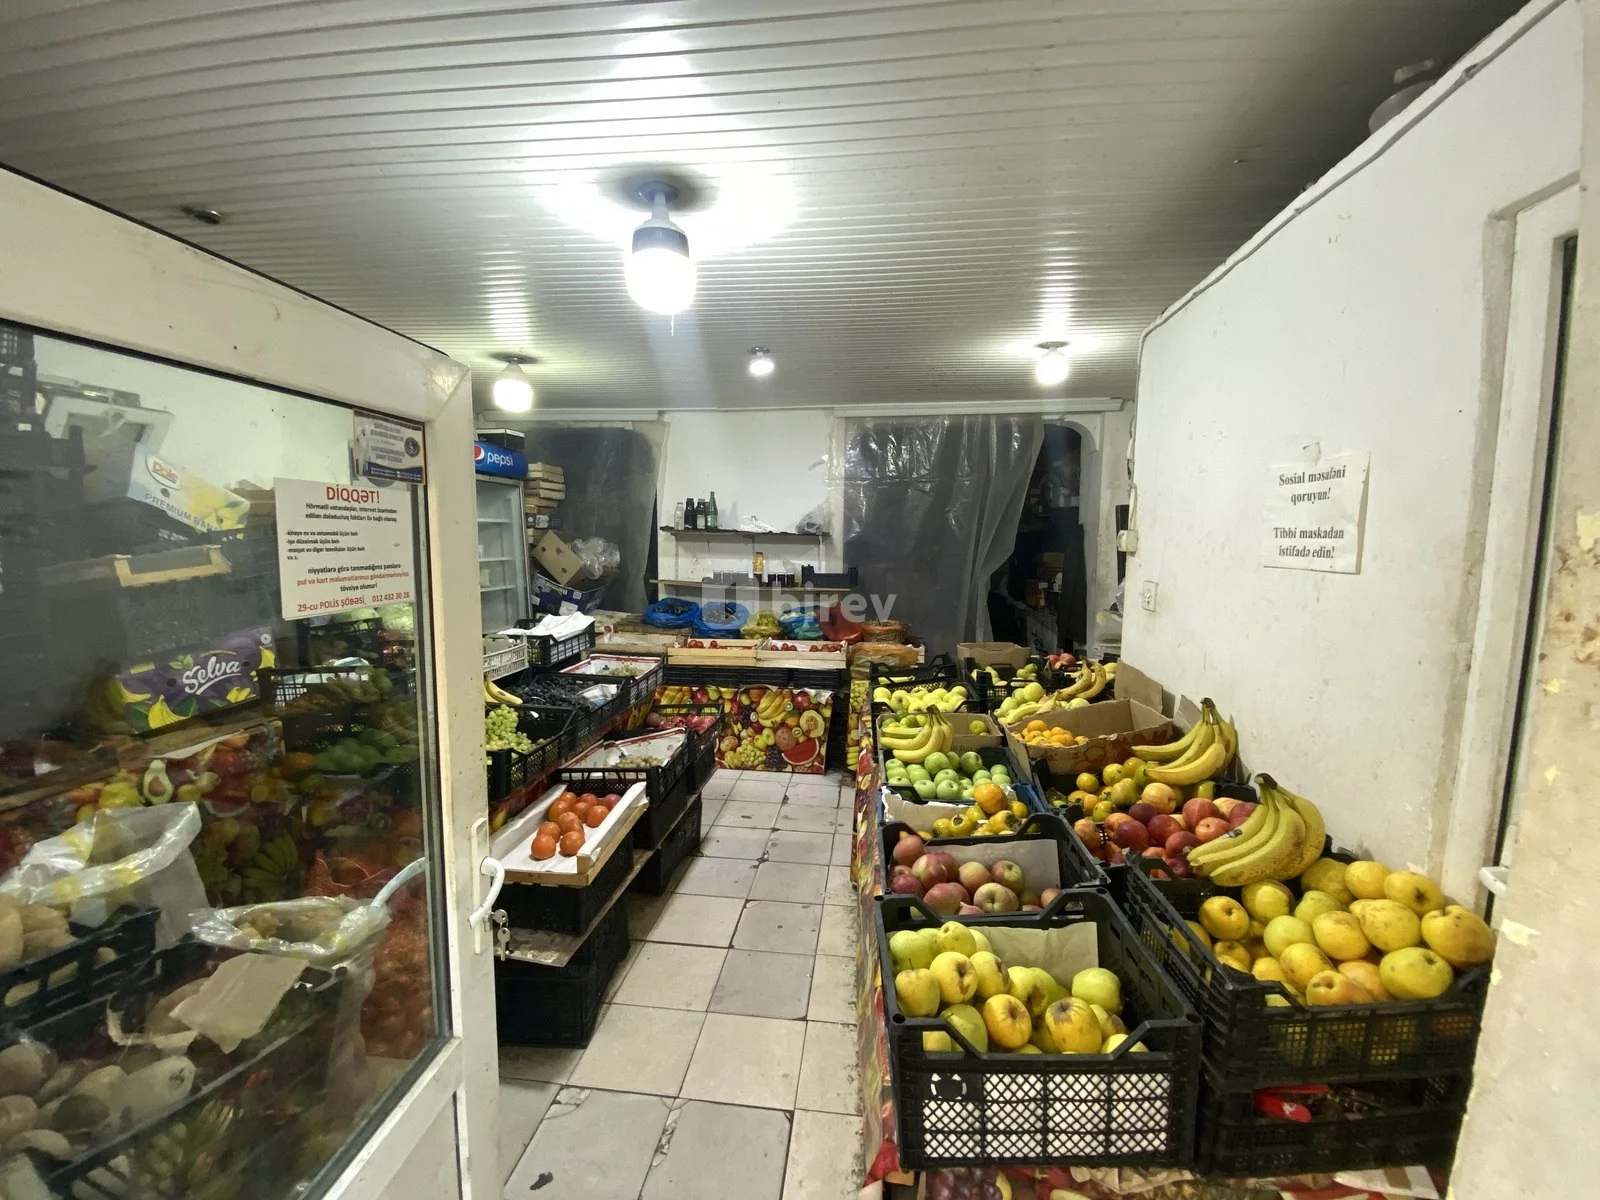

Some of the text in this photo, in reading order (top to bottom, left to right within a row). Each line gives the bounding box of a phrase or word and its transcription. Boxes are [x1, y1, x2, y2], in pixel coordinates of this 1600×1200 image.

[487, 452, 514, 467] pepsi
[1279, 465, 1346, 486] Sosial məsafəni
[326, 484, 380, 504] DİQQƏT!
[1291, 487, 1331, 506] qoruyun!
[145, 493, 192, 521] PREMIUM
[1273, 526, 1344, 539] Tibbi maskadan
[1278, 545, 1335, 559] istifadə edin!
[297, 578, 307, 587] pul
[298, 603, 318, 612] 29-cu
[319, 599, 339, 609] POLİS
[341, 596, 365, 608] ŞÖBƏSİ
[372, 595, 383, 603] 012
[384, 593, 394, 601] 432
[183, 656, 240, 693] Selva
